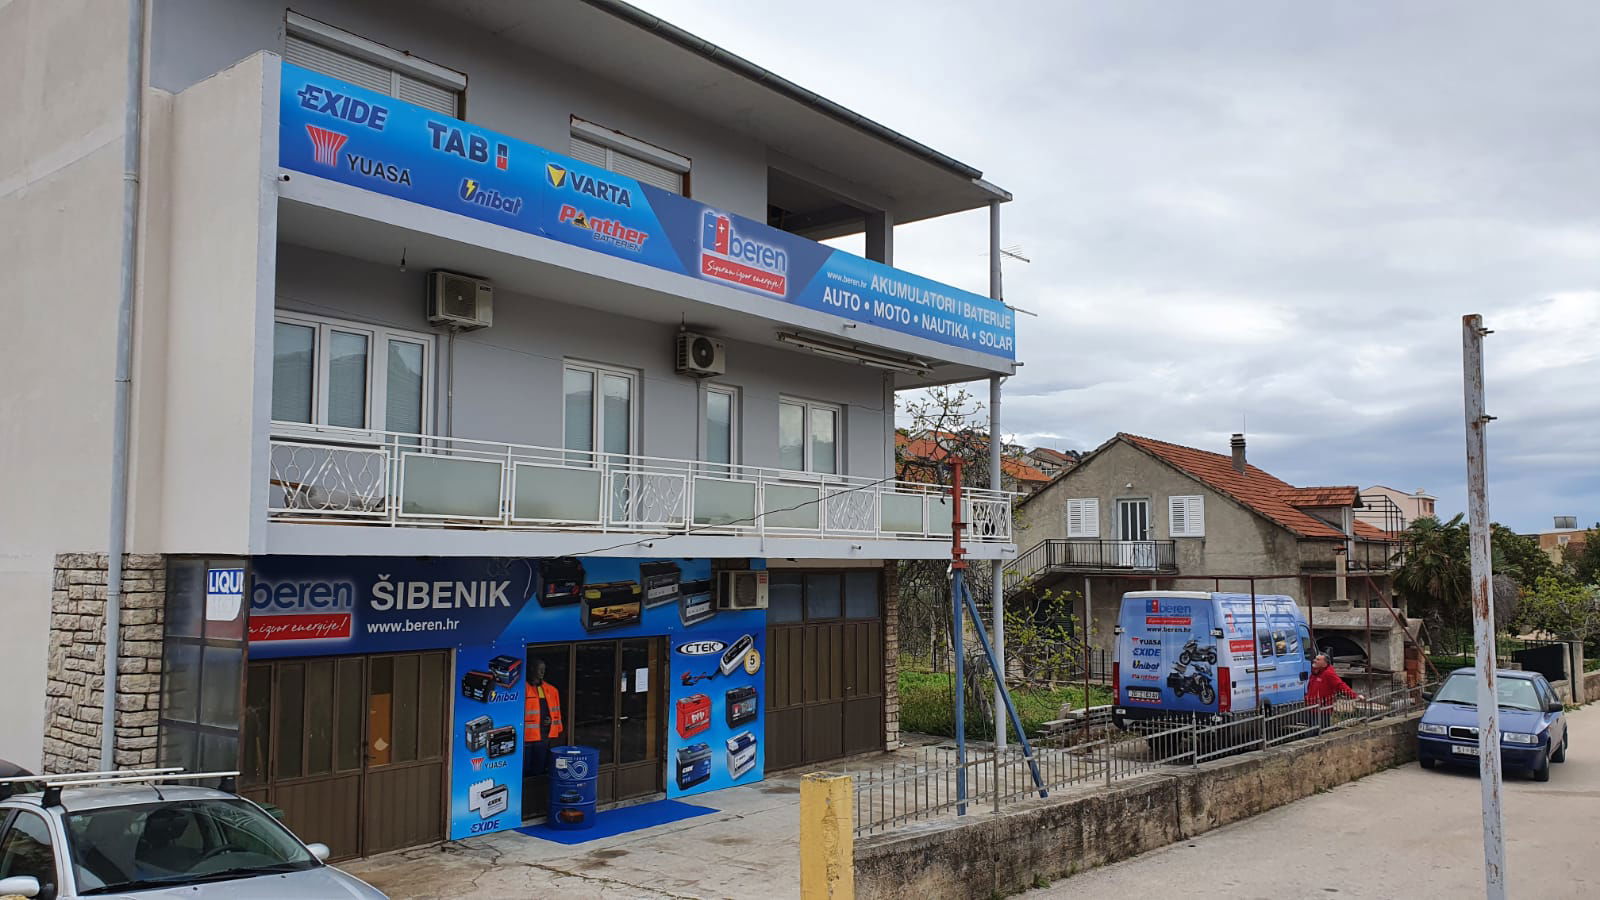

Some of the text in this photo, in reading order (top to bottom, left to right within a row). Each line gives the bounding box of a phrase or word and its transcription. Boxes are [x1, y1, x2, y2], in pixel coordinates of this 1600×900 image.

[297, 84, 388, 131] EXIDE
[427, 121, 488, 163] TAB
[347, 153, 411, 186] YUASA
[459, 179, 521, 215] Unibat
[569, 172, 631, 208] VARTA
[730, 228, 787, 272] beren
[827, 271, 867, 288] www.beren.hr
[870, 274, 956, 314] AKUMULATORI
[964, 304, 1011, 330] BATERIJE
[823, 286, 1013, 352] AUTO MOTO NAUTIKA SOLAR
[250, 574, 352, 609] beren
[370, 574, 511, 611] ŠIBENIK
[1160, 602, 1191, 613] beren
[291, 616, 348, 637] energije!
[367, 618, 460, 633] www.beren.hr
[686, 642, 717, 654] CTEK
[749, 655, 756, 665] 5
[1132, 648, 1161, 656] EXIDE
[489, 690, 519, 704] Unibat
[484, 760, 508, 769] YUASA
[470, 819, 500, 833] EXIDE
